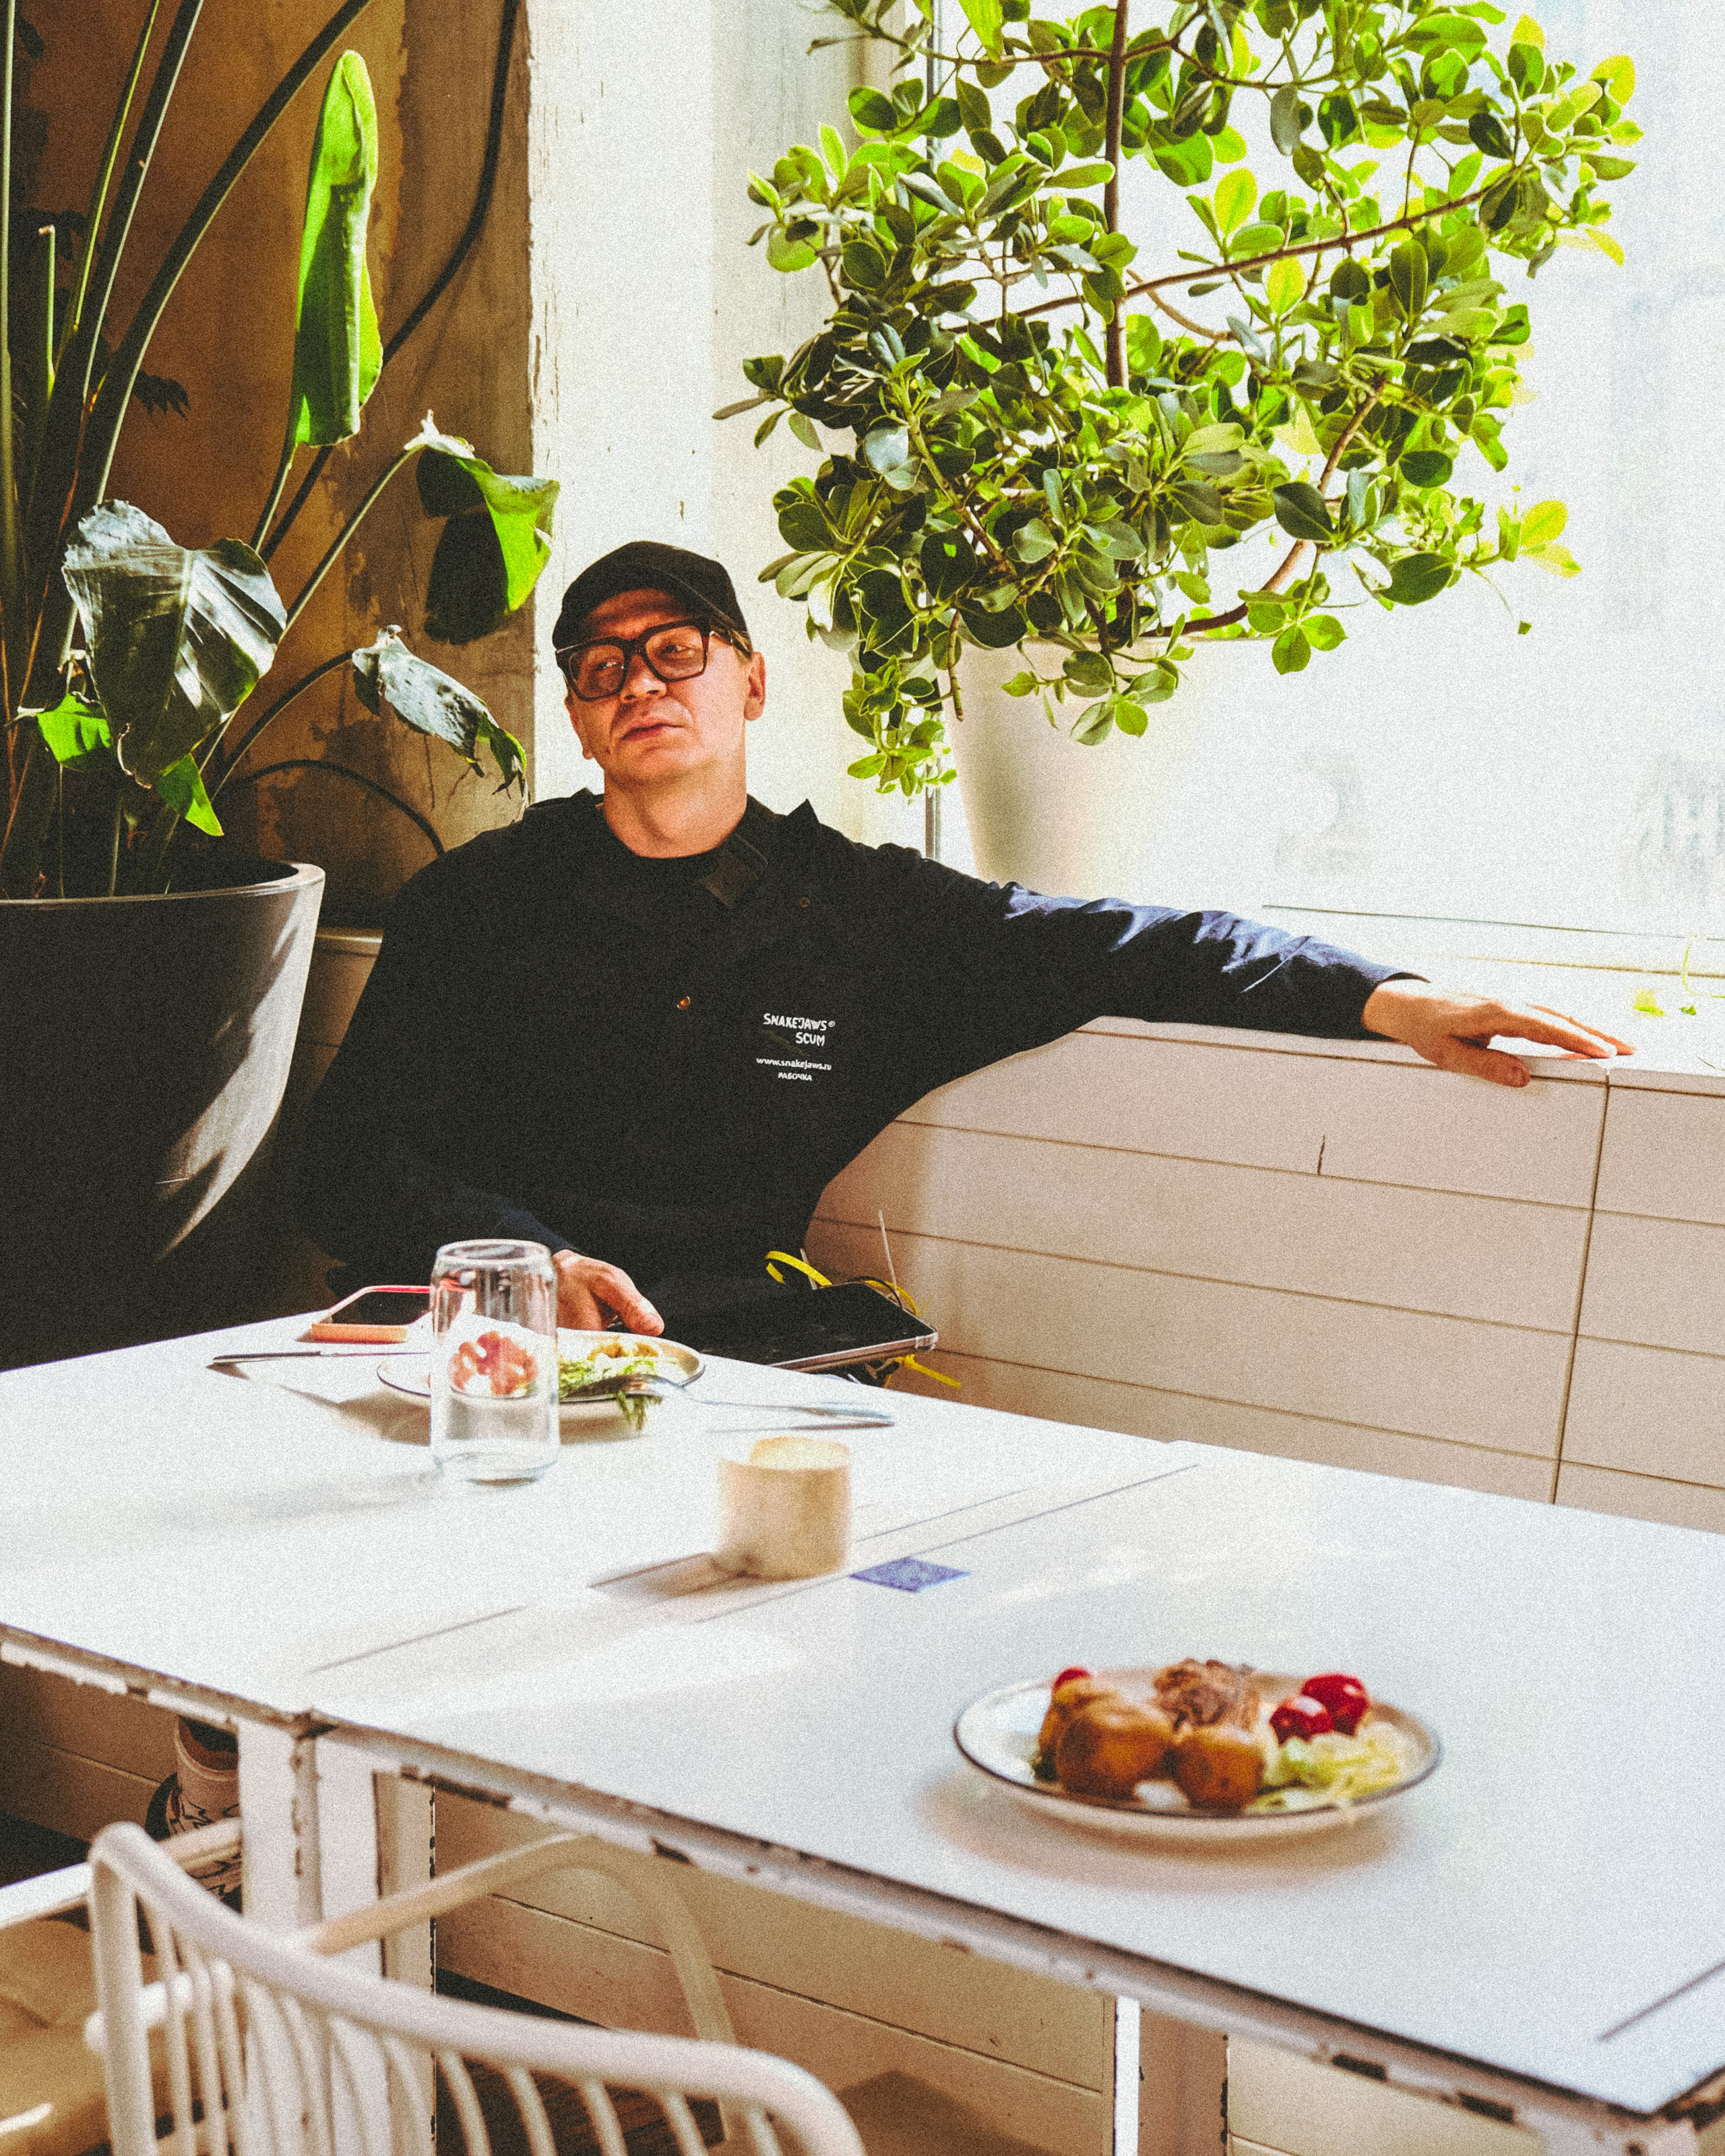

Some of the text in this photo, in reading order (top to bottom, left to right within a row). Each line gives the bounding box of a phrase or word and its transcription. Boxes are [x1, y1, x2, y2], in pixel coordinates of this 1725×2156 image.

[795, 1032, 825, 1046] SCUM
[756, 1058, 832, 1071] www.snakejaws.ru
[778, 1072, 812, 1081] РАБОЧКА
